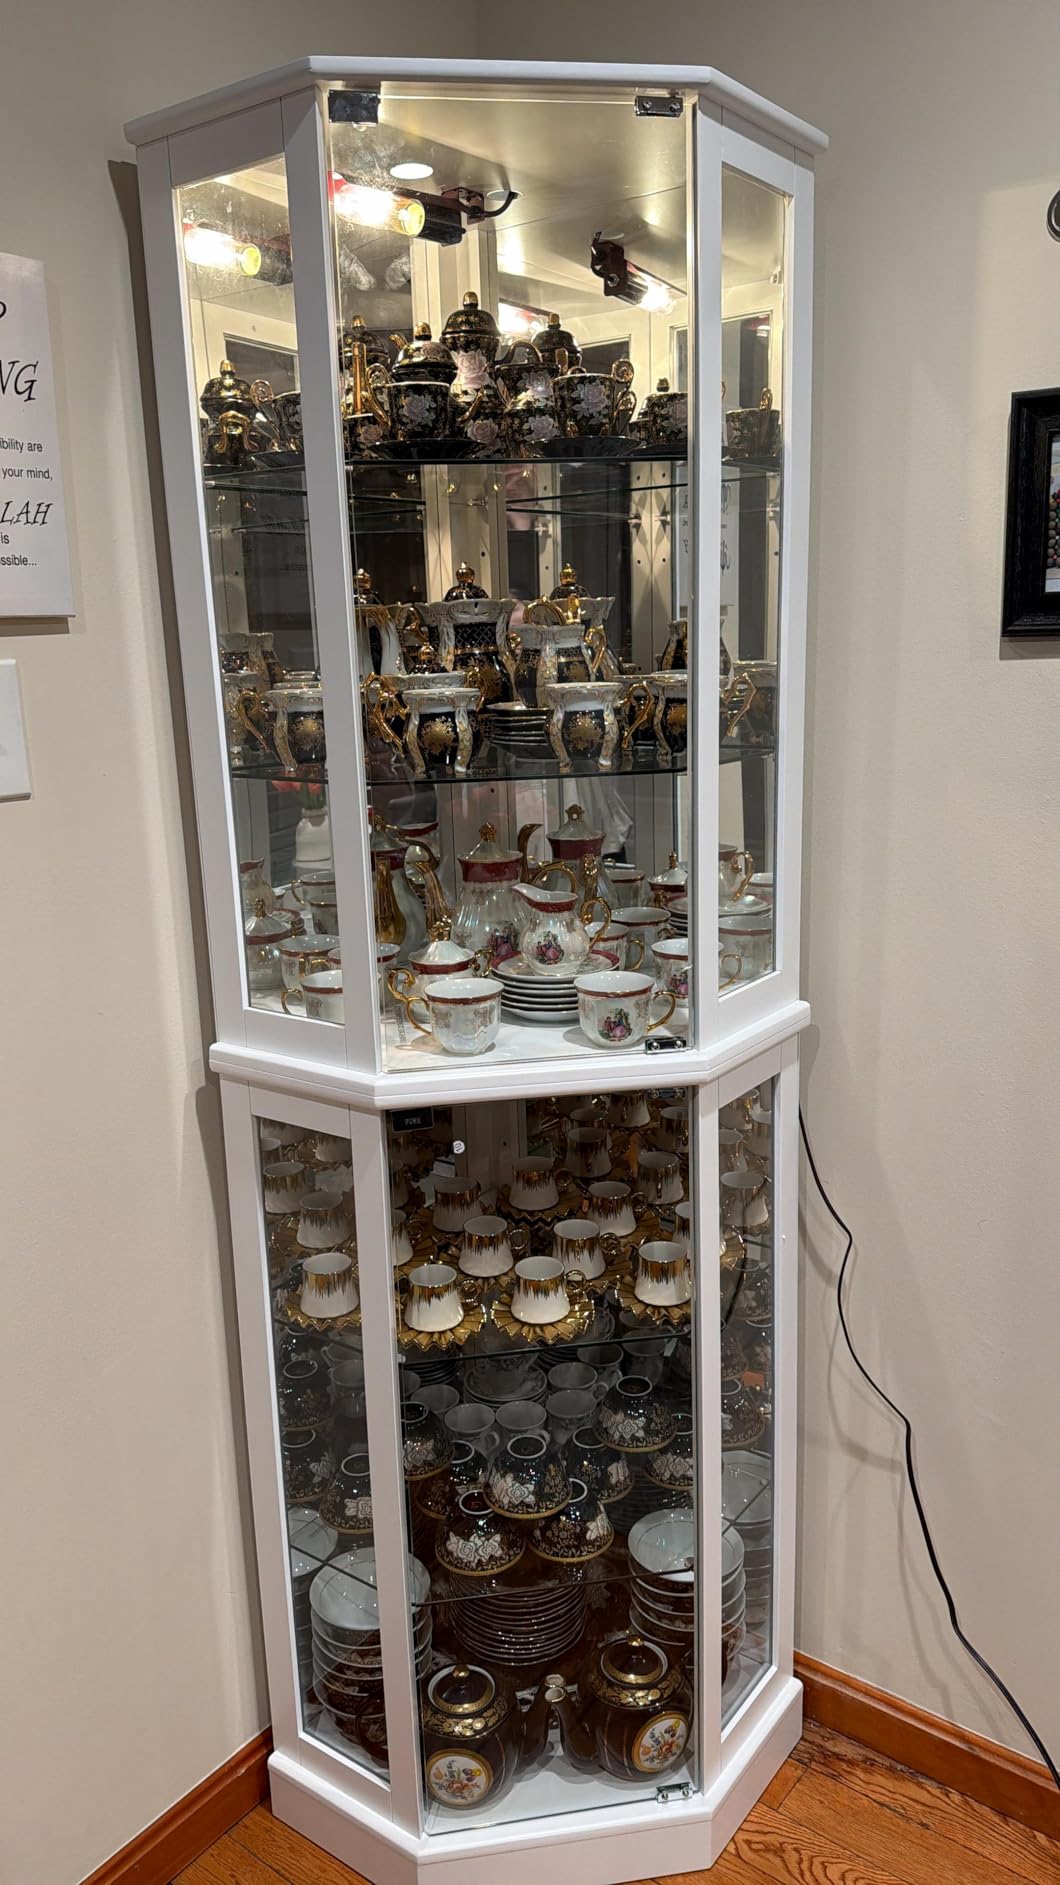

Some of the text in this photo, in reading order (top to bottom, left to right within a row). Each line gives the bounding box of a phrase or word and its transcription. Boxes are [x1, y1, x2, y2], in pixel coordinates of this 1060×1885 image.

[27, 442, 43, 453] are
[2, 467, 53, 481] your mind,
[0, 500, 54, 526] LAH
[0, 531, 10, 544] is
